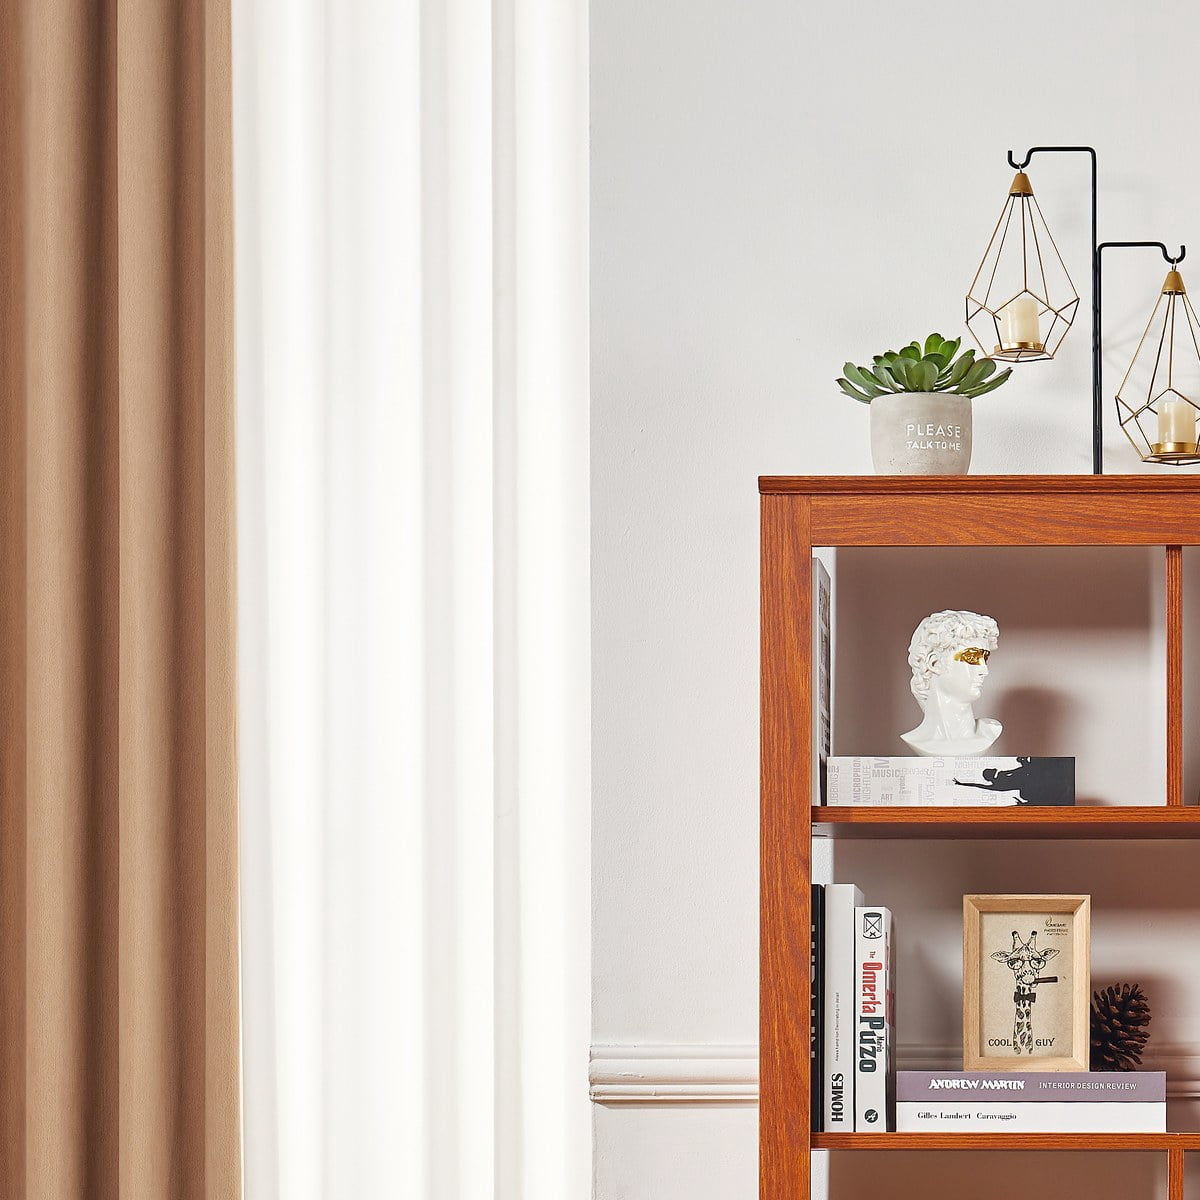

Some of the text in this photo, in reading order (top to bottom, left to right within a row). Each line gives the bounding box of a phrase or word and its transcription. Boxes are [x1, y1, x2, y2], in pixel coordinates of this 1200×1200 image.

[907, 424, 960, 438] PLEASE
[906, 441, 960, 451] TALK TO ME
[872, 769, 901, 778] MUSIC
[862, 962, 883, 1014] Omerta
[859, 1016, 885, 1073] Puzo
[876, 1036, 885, 1052] Mario
[988, 1037, 1056, 1047] COOL GUY
[928, 1079, 1025, 1090] ANDREW MARTIN
[1076, 1082, 1105, 1090] DESIGN
[1106, 1082, 1137, 1090] REVIEW
[831, 1073, 844, 1122] HOMES
[917, 1111, 1017, 1121] Gilles Lambert Caravaggio
